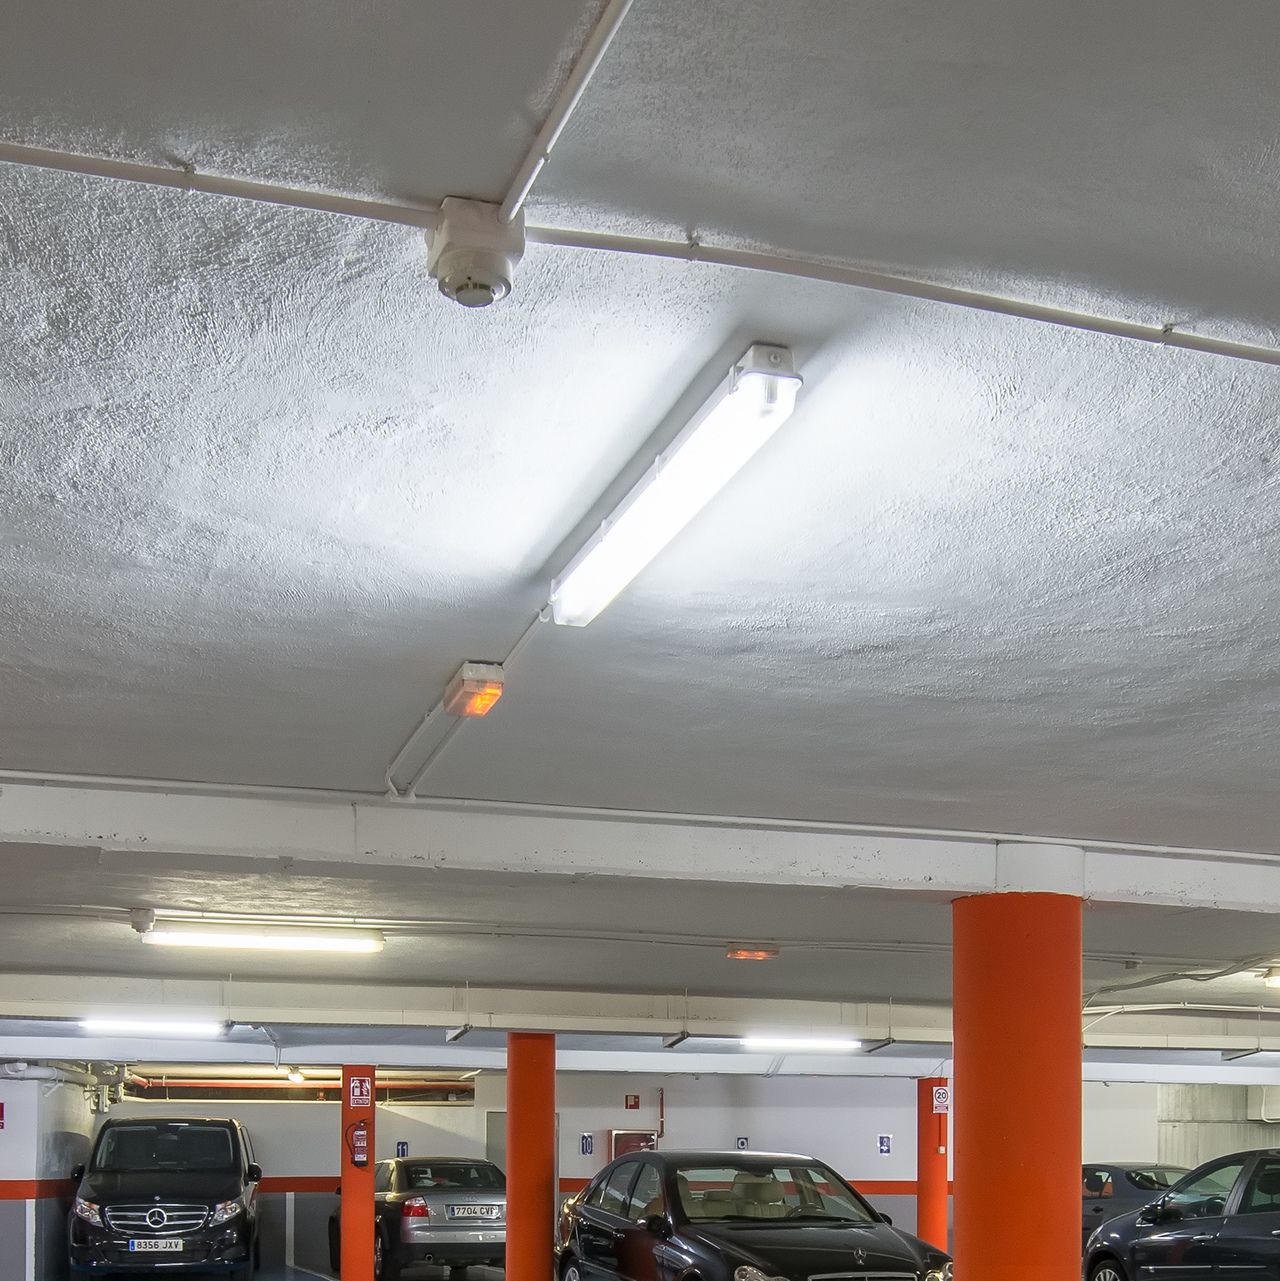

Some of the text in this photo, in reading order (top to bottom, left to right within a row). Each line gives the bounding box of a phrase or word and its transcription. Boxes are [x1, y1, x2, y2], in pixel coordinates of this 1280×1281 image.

[398, 1144, 407, 1157] 11
[582, 1137, 592, 1153] 10
[456, 1207, 477, 1215] 7704
[136, 1241, 179, 1250] 8356 JXV
